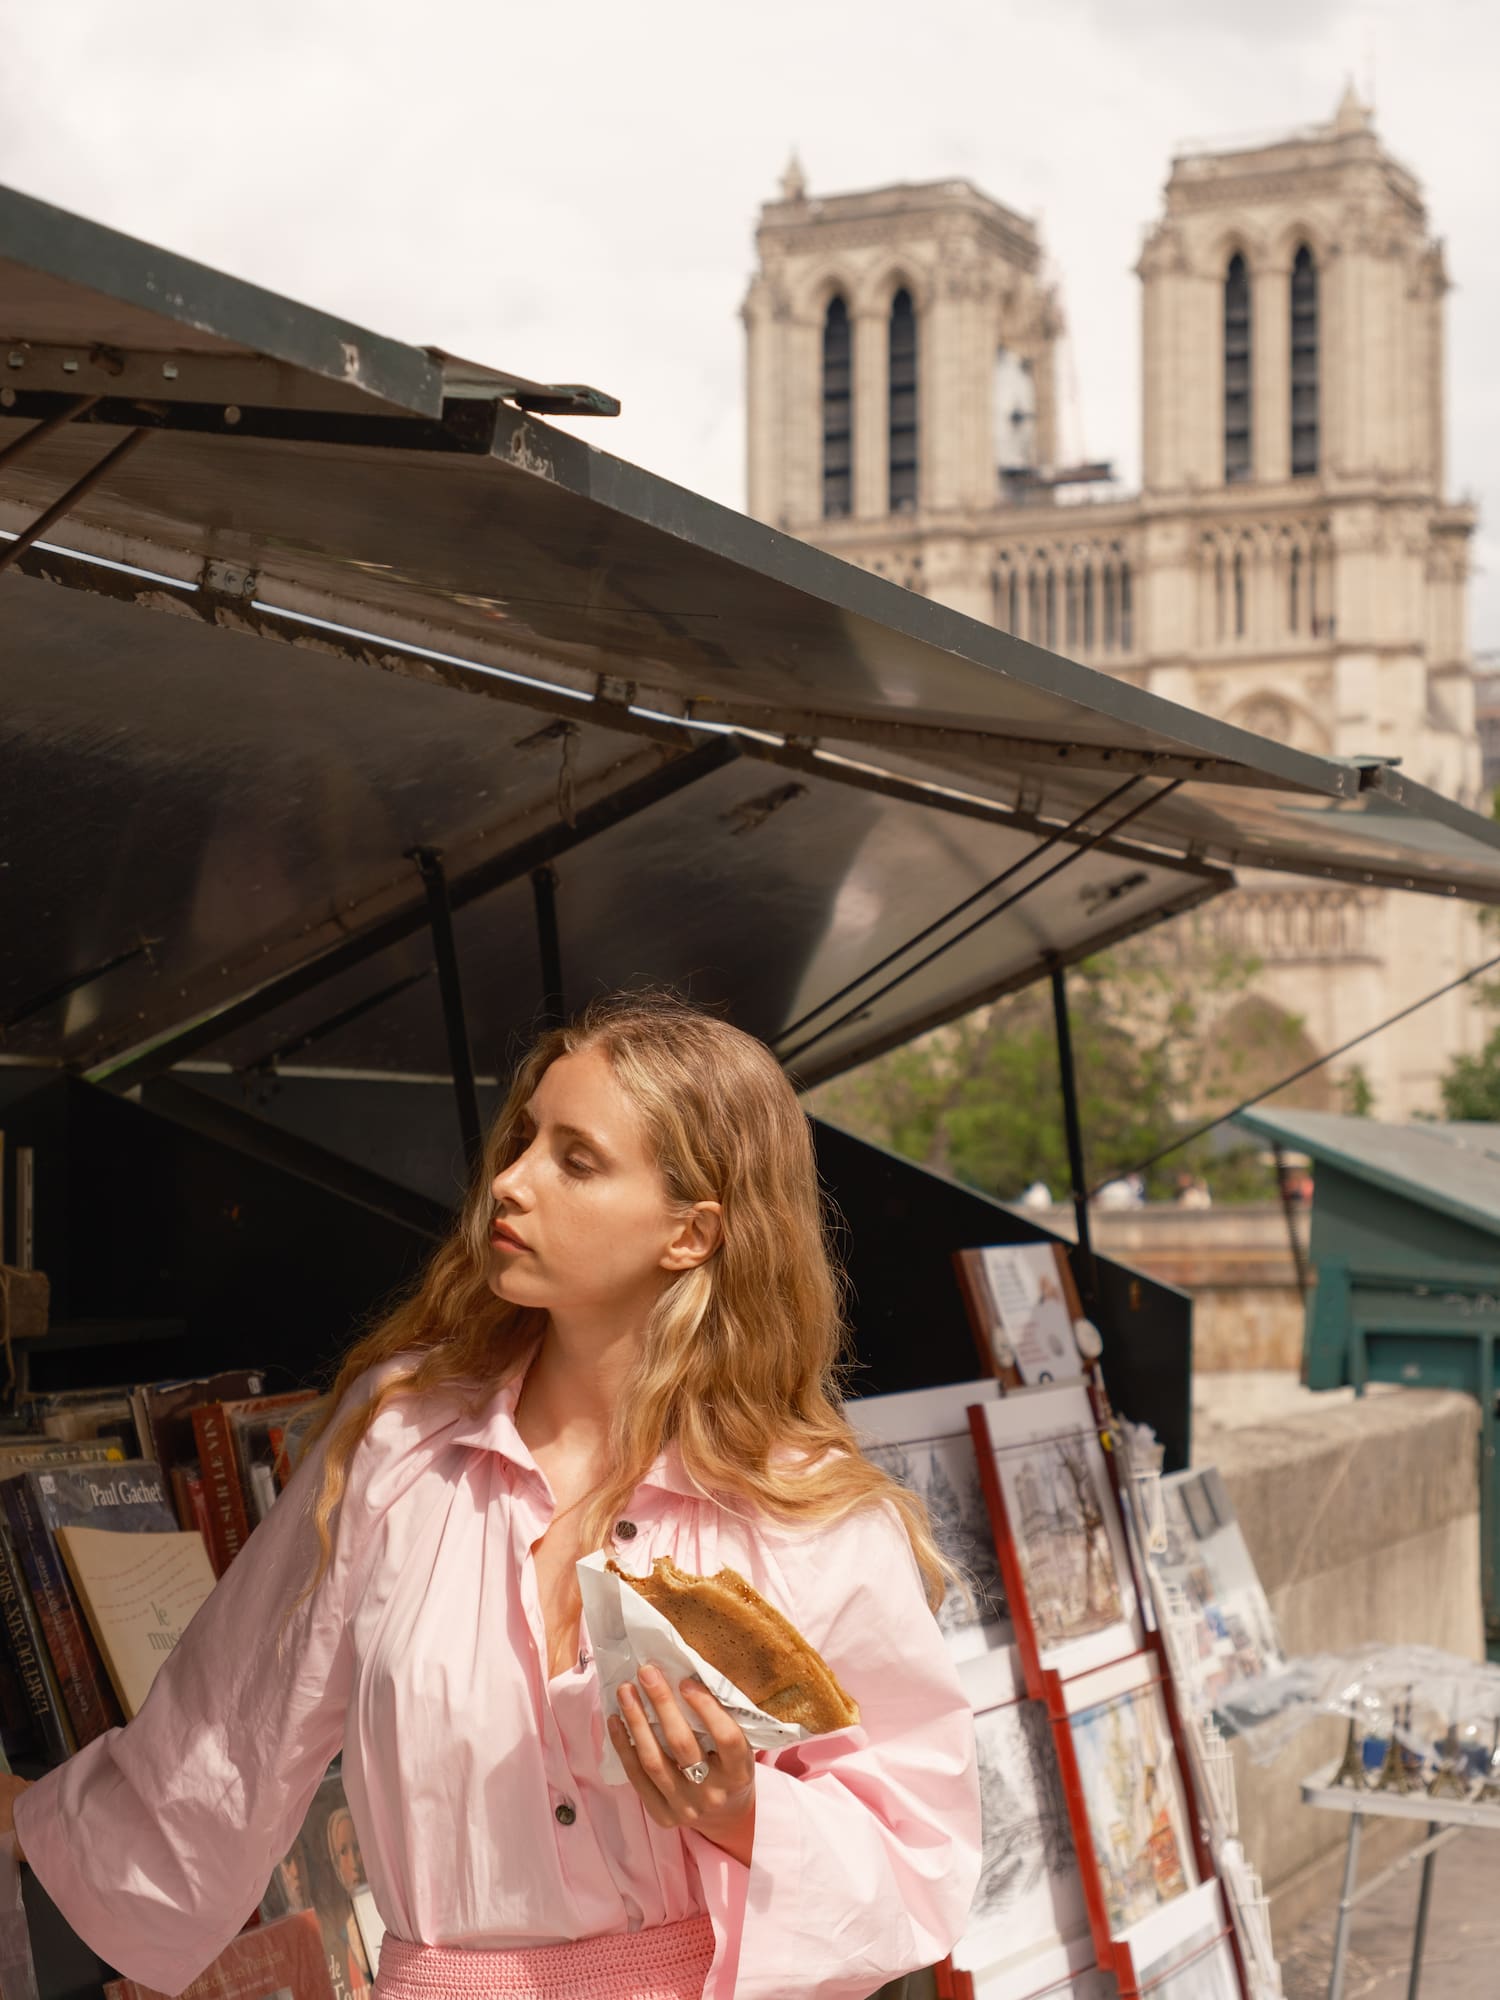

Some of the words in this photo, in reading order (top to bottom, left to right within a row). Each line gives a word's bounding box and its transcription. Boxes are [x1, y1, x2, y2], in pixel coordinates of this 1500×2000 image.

[204, 1418, 220, 1451] VIN
[211, 1455, 226, 1480] LE
[89, 1482, 120, 1506] Paul
[118, 1479, 164, 1505] Gachet
[216, 1484, 232, 1522] SUR
[150, 1601, 170, 1626] le
[17, 1642, 36, 1666] DU
[23, 1669, 50, 1715] L'ART
[329, 1954, 341, 1980] de
